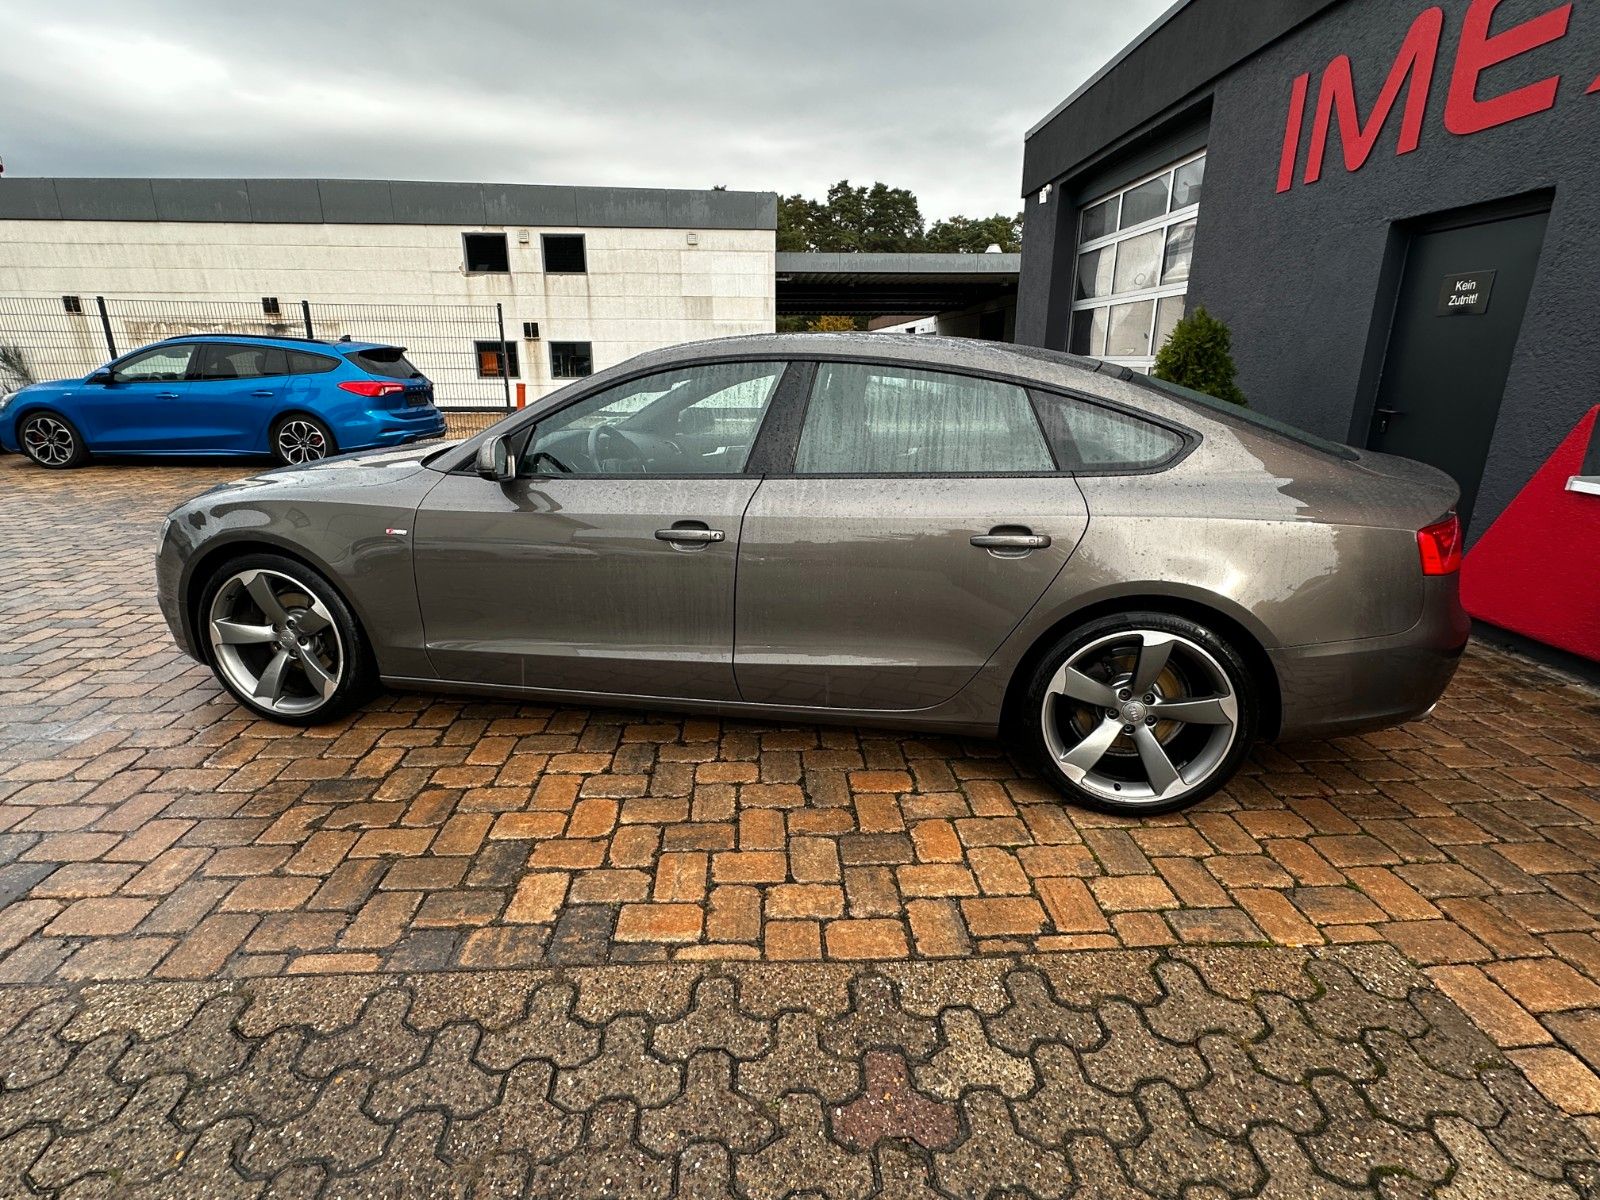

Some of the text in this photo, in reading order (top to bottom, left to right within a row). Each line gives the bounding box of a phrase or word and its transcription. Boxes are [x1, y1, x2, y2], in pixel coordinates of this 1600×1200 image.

[1276, 0, 1600, 194] IME
[1455, 280, 1476, 291] Kein
[1448, 293, 1479, 306] Zutritt!
